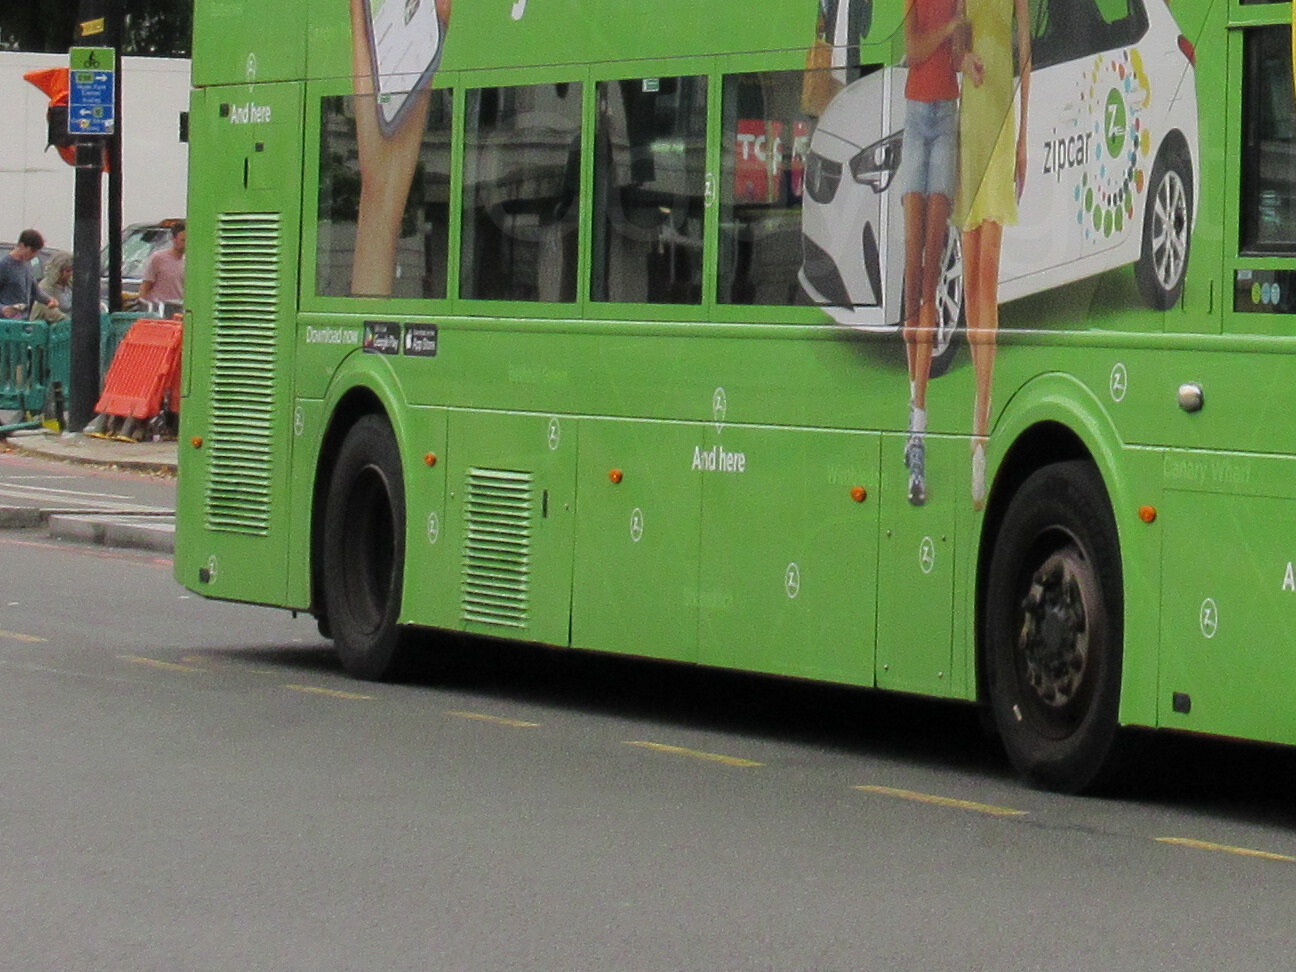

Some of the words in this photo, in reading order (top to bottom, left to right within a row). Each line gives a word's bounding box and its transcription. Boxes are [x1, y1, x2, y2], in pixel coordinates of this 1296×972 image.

[230, 103, 249, 124] And
[250, 103, 272, 124] here
[1043, 126, 1093, 183] zipcar
[306, 325, 342, 344] Download
[692, 444, 716, 472] And
[718, 446, 746, 473] here
